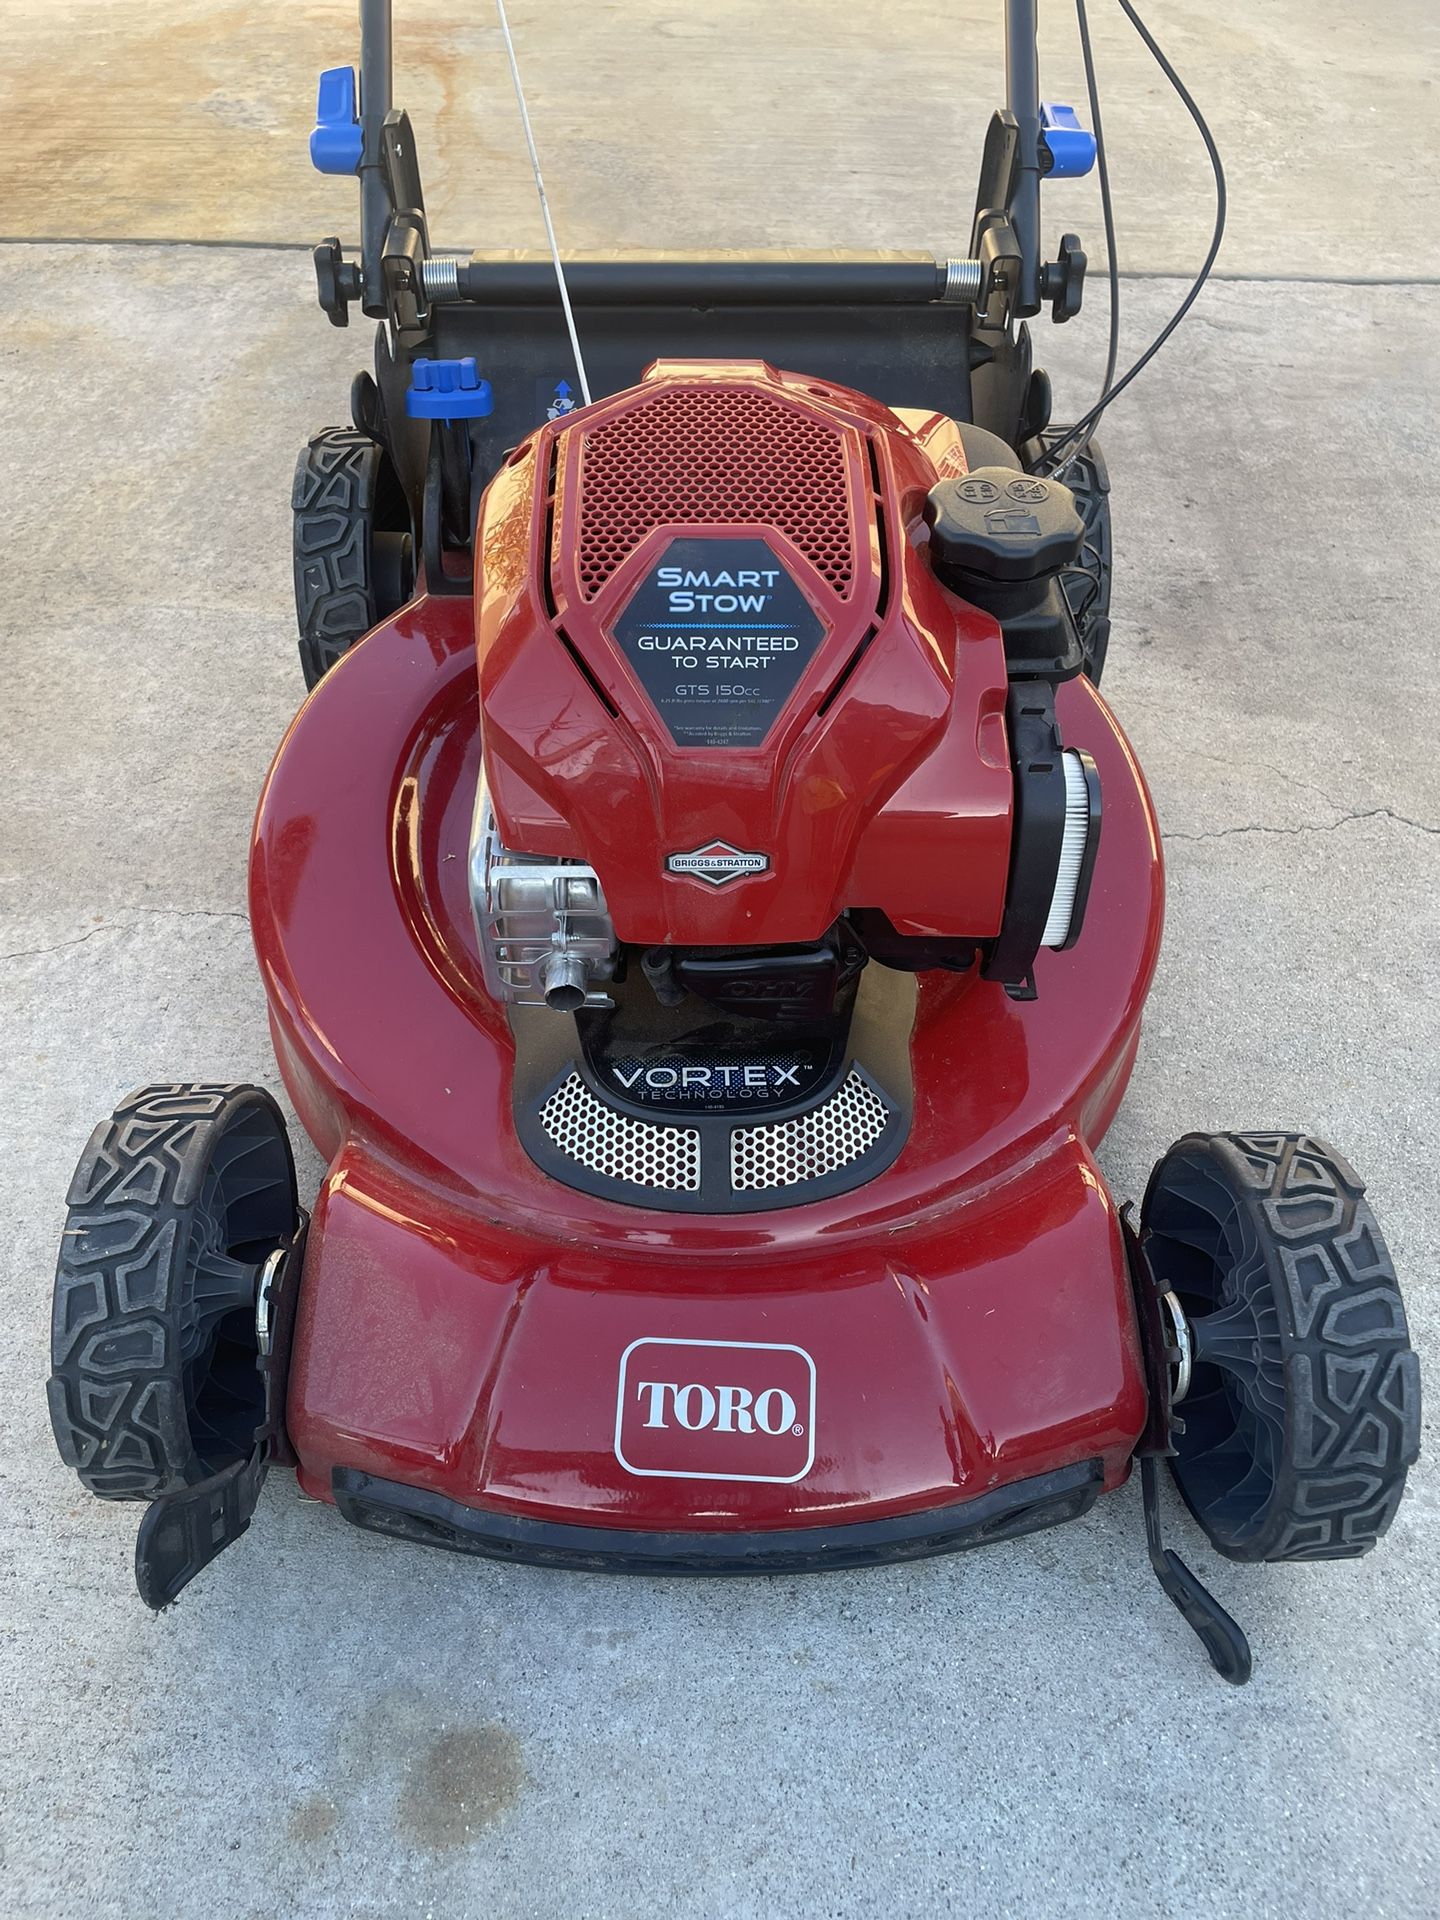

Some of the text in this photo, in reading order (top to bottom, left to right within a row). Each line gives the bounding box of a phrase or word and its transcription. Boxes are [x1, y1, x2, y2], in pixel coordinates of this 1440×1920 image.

[657, 567, 780, 587] SMART
[637, 636, 799, 651] GUARANTEED
[671, 656, 698, 669] TO
[675, 684, 761, 696] GTS 150cc
[637, 1088, 785, 1100] TECHNOLOGY
